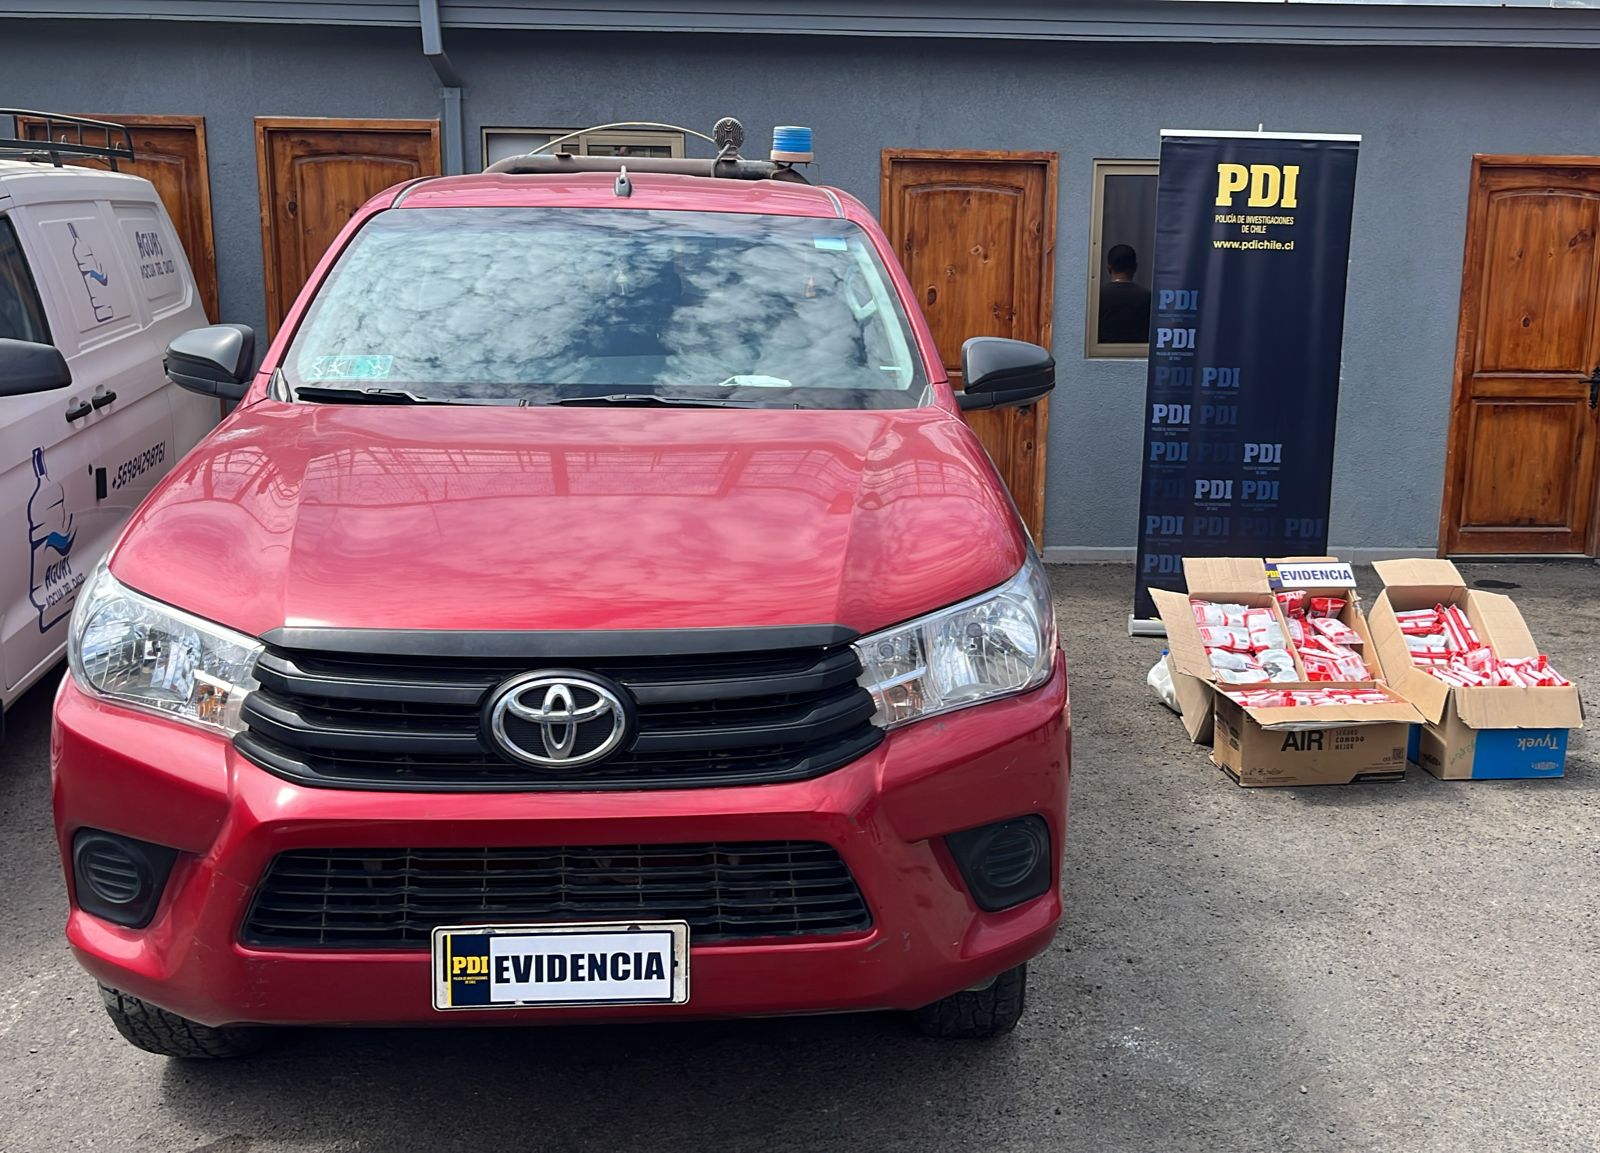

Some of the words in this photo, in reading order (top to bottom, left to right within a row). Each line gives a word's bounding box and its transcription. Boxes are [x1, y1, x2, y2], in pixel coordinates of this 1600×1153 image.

[1215, 163, 1300, 208] PDI
[1215, 213, 1236, 223] POLICÍA
[1237, 215, 1245, 223] DE
[1246, 215, 1294, 225] INVESTIGACIONES
[1241, 225, 1249, 233] DE
[1250, 225, 1267, 233] CHILE
[1213, 240, 1294, 250] www.pdichile.cl
[1159, 289, 1199, 311] PDI
[1156, 328, 1196, 348] PDI
[1155, 366, 1193, 387] PDI
[1202, 367, 1240, 387] PDI
[1152, 404, 1191, 424] PDI
[1200, 405, 1238, 425] PDI
[1150, 442, 1189, 462] PDI
[1243, 443, 1282, 464] PDI
[1194, 480, 1233, 500] PDI
[1241, 480, 1280, 500] PDI
[1145, 516, 1184, 536] PDI
[1192, 516, 1231, 536] PDI
[1284, 518, 1323, 537] PDI
[1143, 554, 1181, 574] PDI
[1280, 570, 1353, 580] EVIDENCIA
[1281, 730, 1324, 751] AIR
[1517, 734, 1559, 750] Tyvek
[452, 956, 489, 974] PDI
[494, 952, 665, 984] EVIDENCIA
